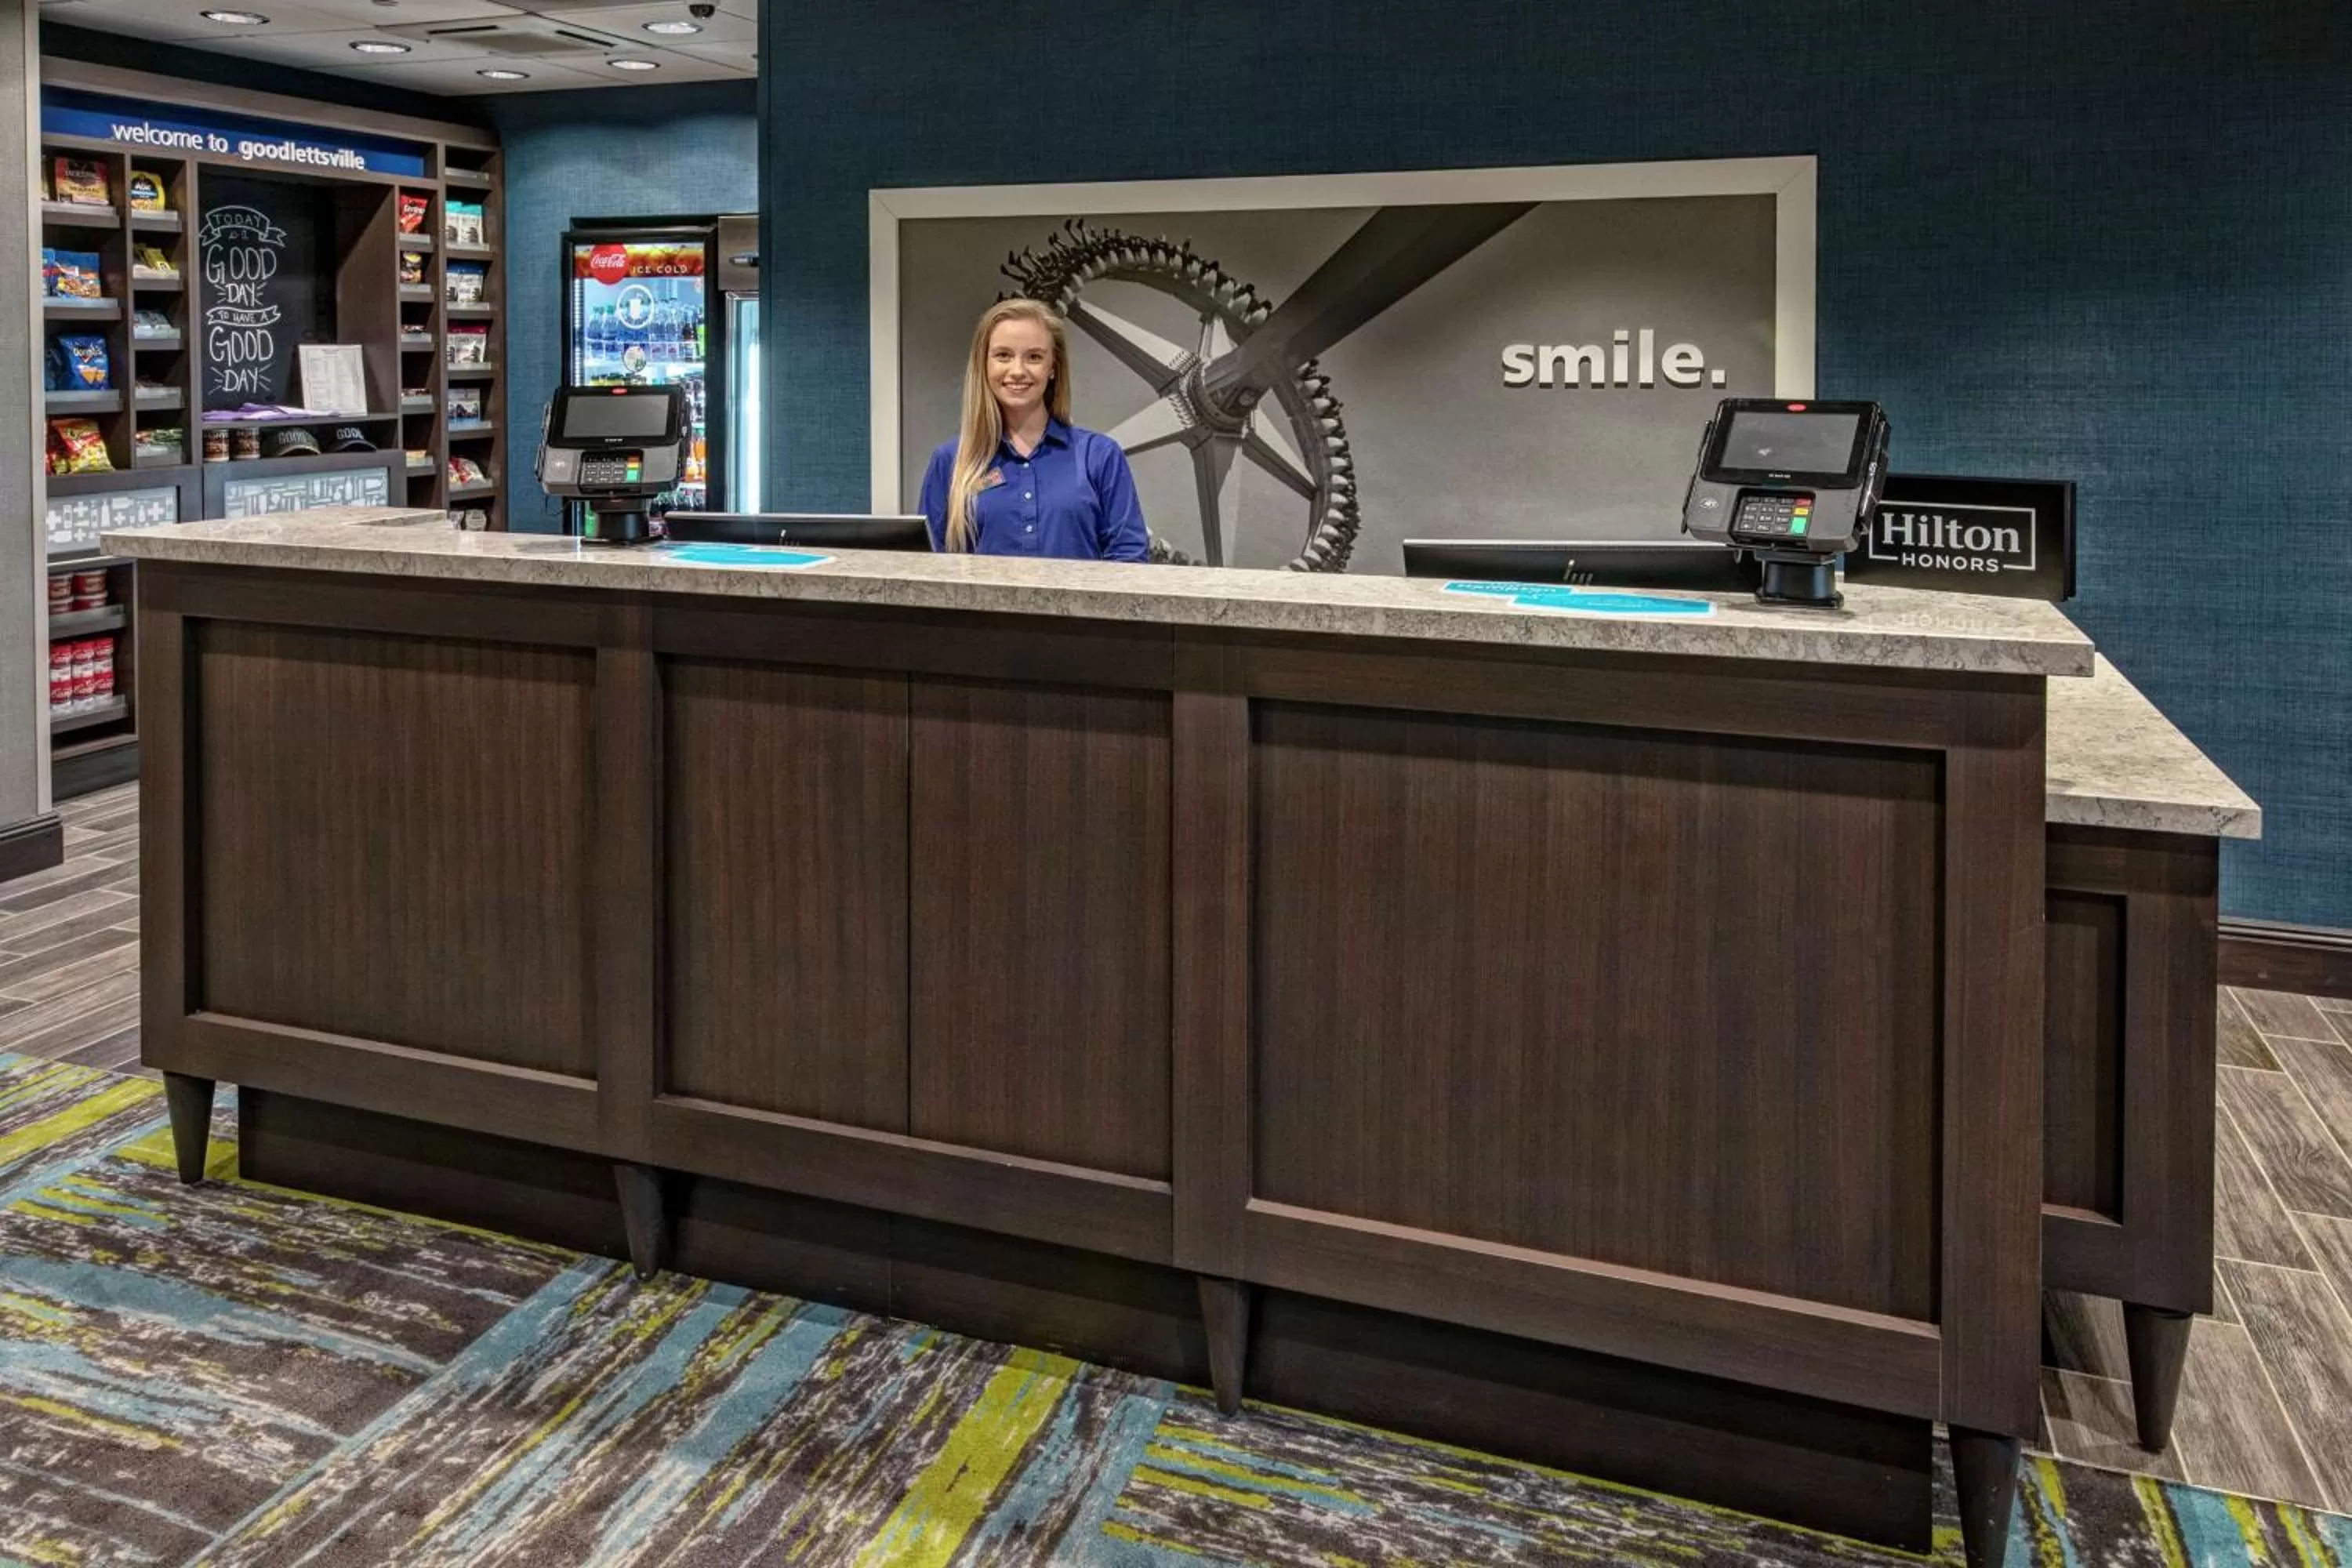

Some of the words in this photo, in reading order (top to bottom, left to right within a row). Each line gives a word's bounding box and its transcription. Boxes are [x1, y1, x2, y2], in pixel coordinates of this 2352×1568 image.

[111, 122, 204, 151] welcome
[207, 133, 229, 153] to
[238, 140, 366, 170] goodlettsville
[212, 213, 261, 227] TODAY
[206, 243, 278, 285] GOOD
[632, 265, 652, 274] ICE
[656, 264, 688, 274] COLD
[224, 281, 256, 307] DAY
[217, 310, 230, 320] TO
[233, 313, 256, 324] HAVE
[260, 310, 269, 322] A
[209, 326, 274, 367] GOOD
[1501, 328, 1727, 389] smile.
[223, 367, 258, 394] DAY
[1882, 512, 2021, 554] Hilton
[1902, 552, 1999, 573] HONORS
